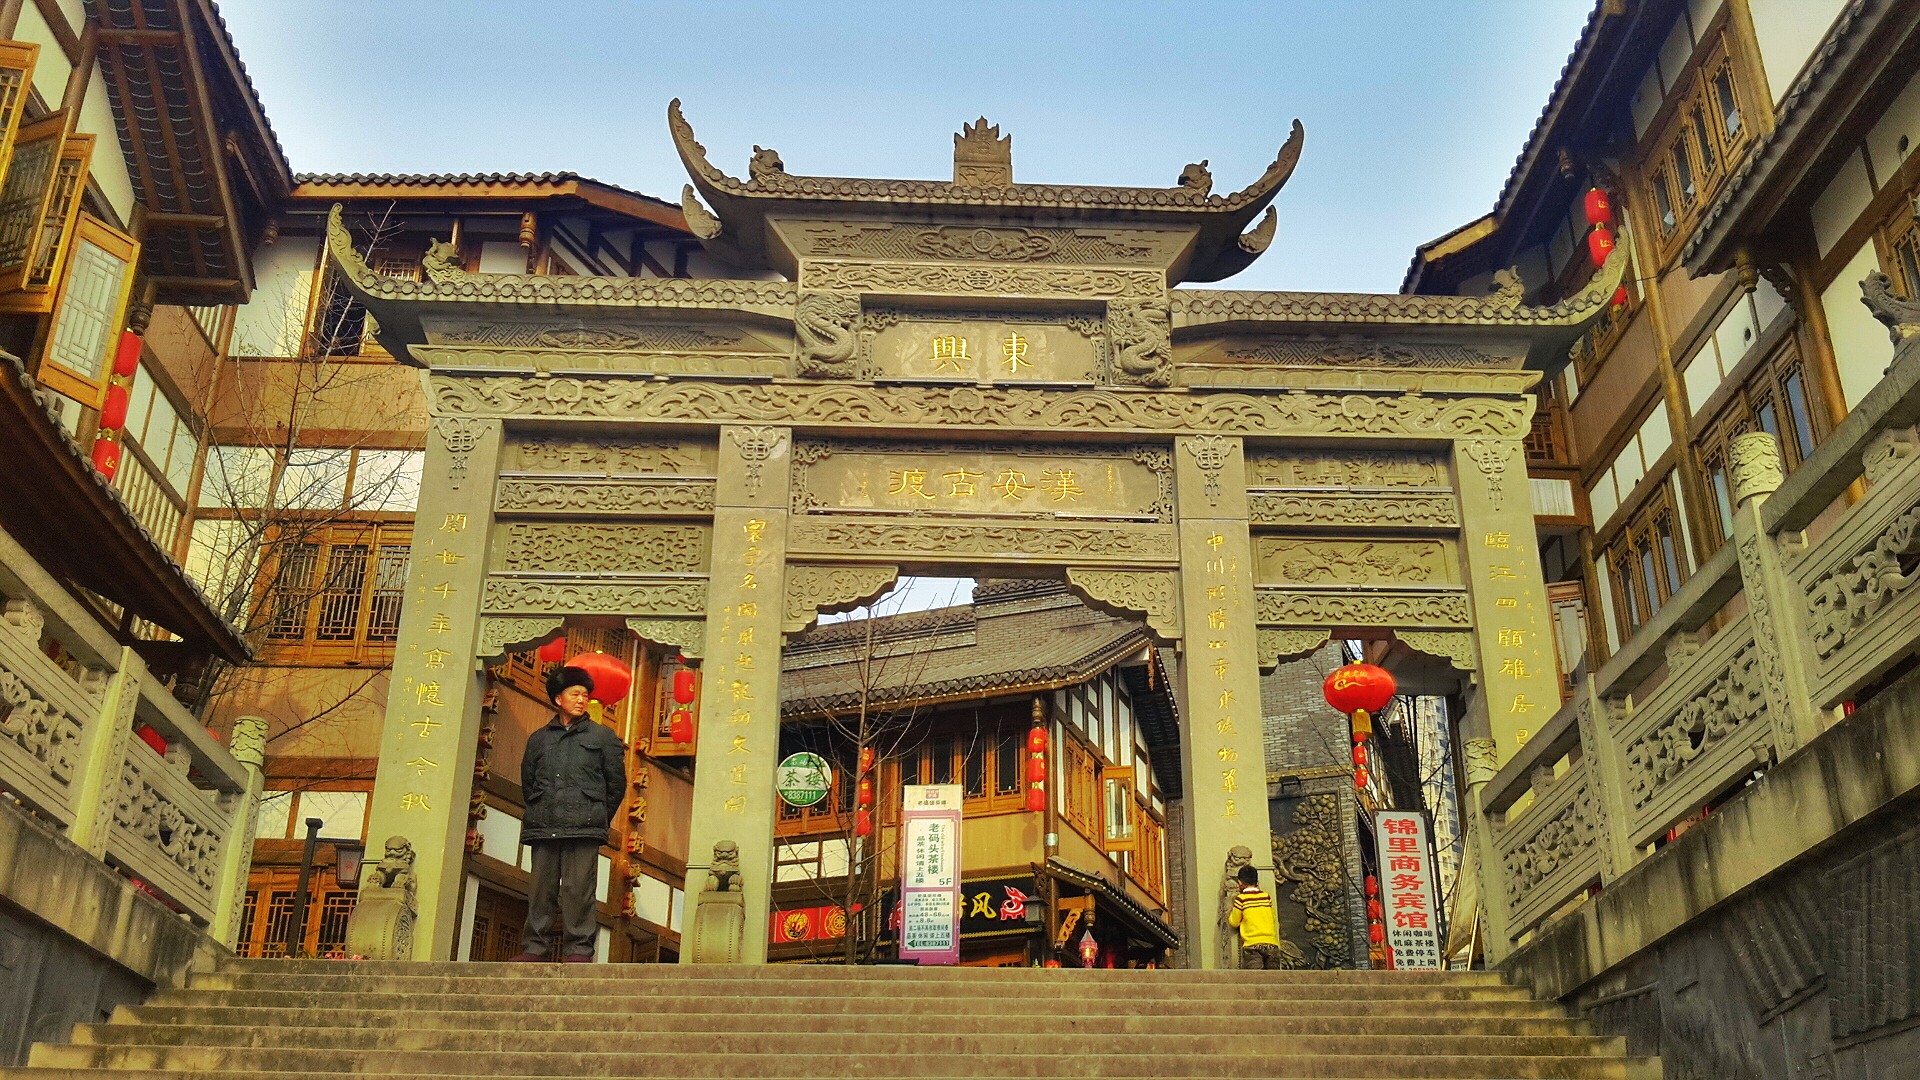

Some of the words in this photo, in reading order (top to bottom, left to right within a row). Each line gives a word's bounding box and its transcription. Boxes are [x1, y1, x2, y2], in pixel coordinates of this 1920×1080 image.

[787, 791, 816, 800] 8387111
[928, 823, 939, 874] 老码头茶楼
[1382, 818, 1428, 929] 锦里商务宾馆
[939, 877, 952, 886] 5F
[1392, 929, 1433, 938] 休闲咖啡
[1393, 939, 1435, 947] 机麻茶楼
[1394, 948, 1436, 957] 免费停车
[1395, 958, 1437, 967] 免费上网
